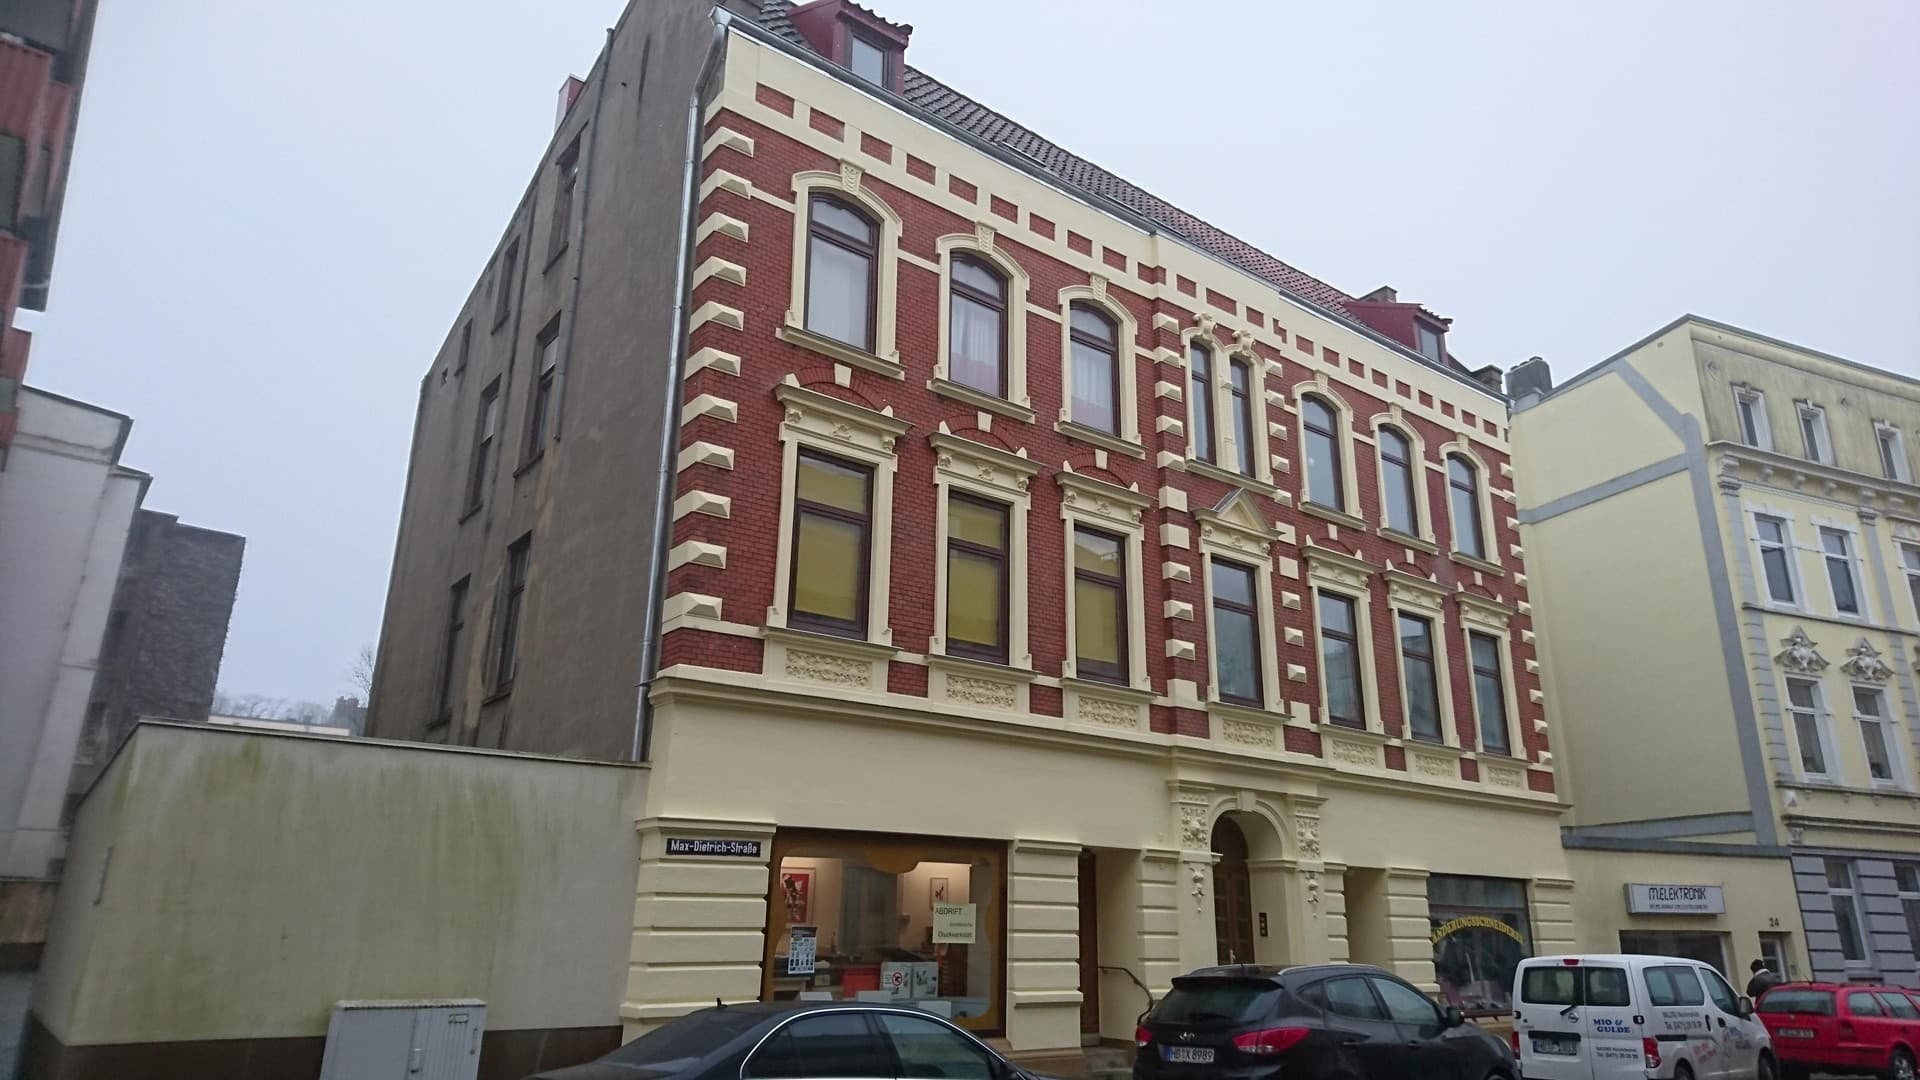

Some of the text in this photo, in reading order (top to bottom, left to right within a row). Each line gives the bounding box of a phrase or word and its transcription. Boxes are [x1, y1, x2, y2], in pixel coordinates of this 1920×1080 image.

[671, 839, 757, 854] Max-Dietrich-Straße
[1593, 1018, 1613, 1026] MIO
[1597, 1026, 1631, 1034] GULDE
